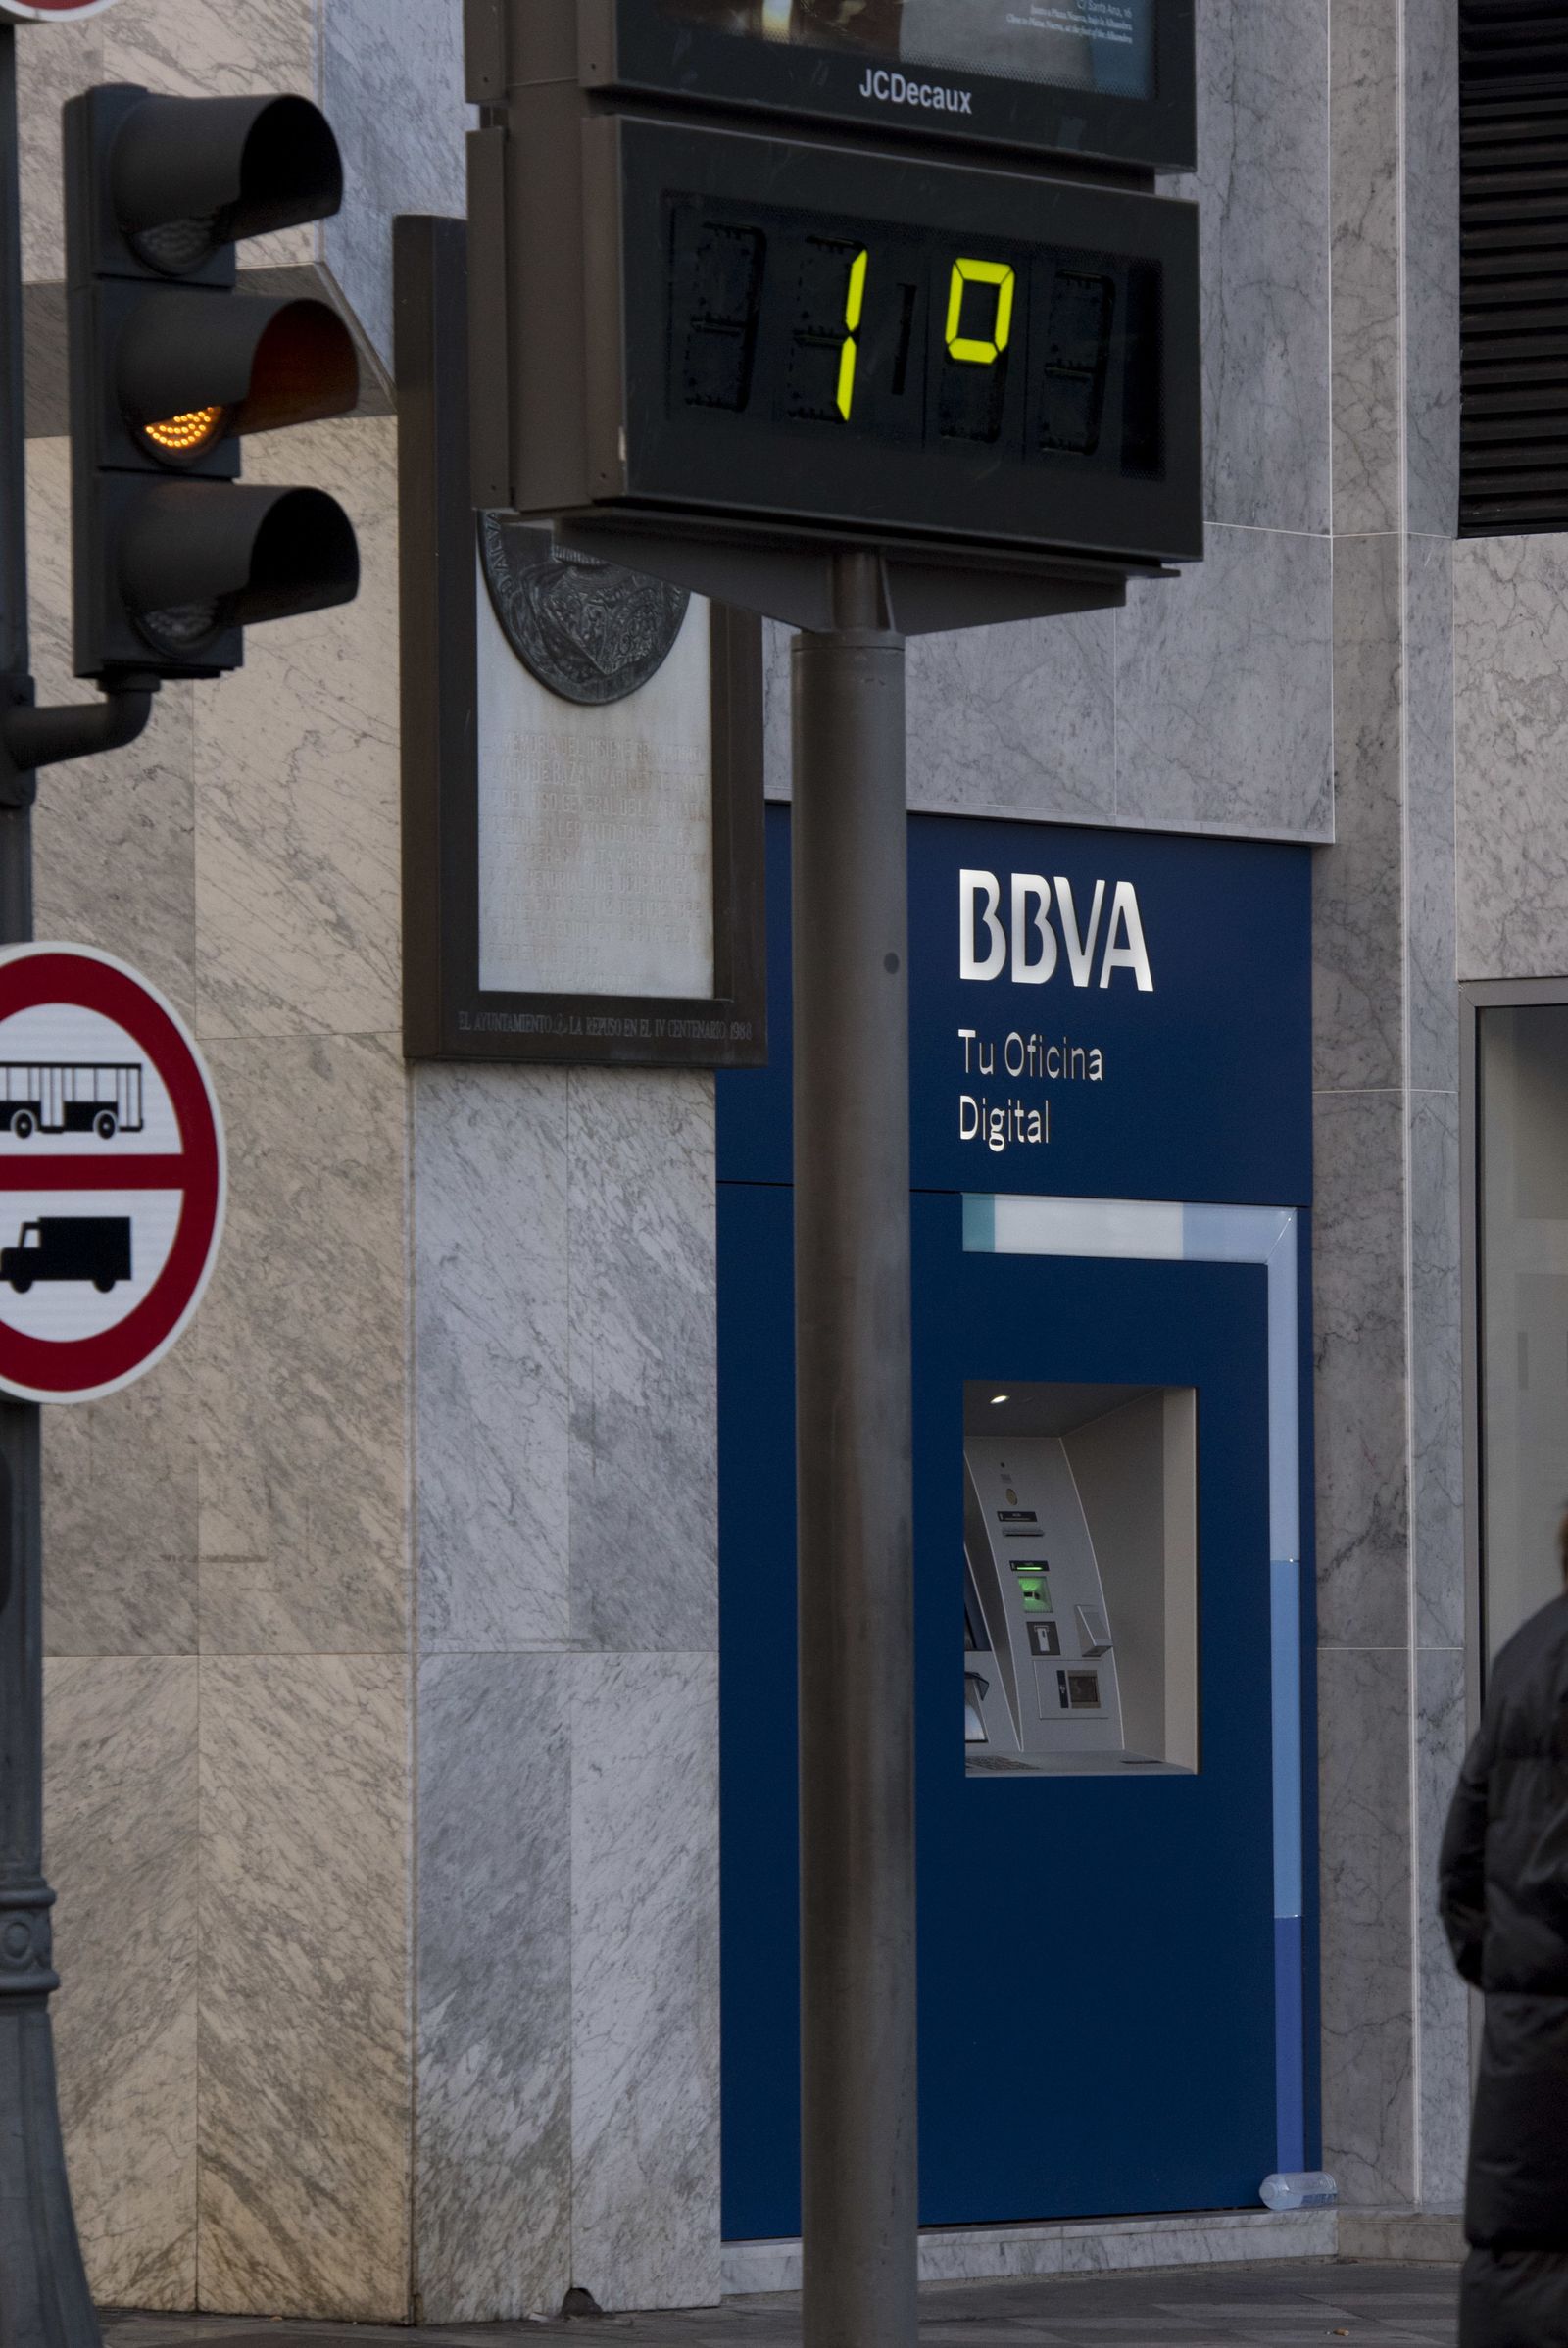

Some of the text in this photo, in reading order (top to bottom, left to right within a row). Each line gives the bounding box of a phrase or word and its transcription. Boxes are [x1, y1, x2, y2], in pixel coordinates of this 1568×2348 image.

[859, 68, 972, 114] JCDecaux
[959, 869, 1154, 992] BBVA
[958, 1029, 1103, 1082] Tu Oficina
[959, 1095, 1050, 1152] Digital
